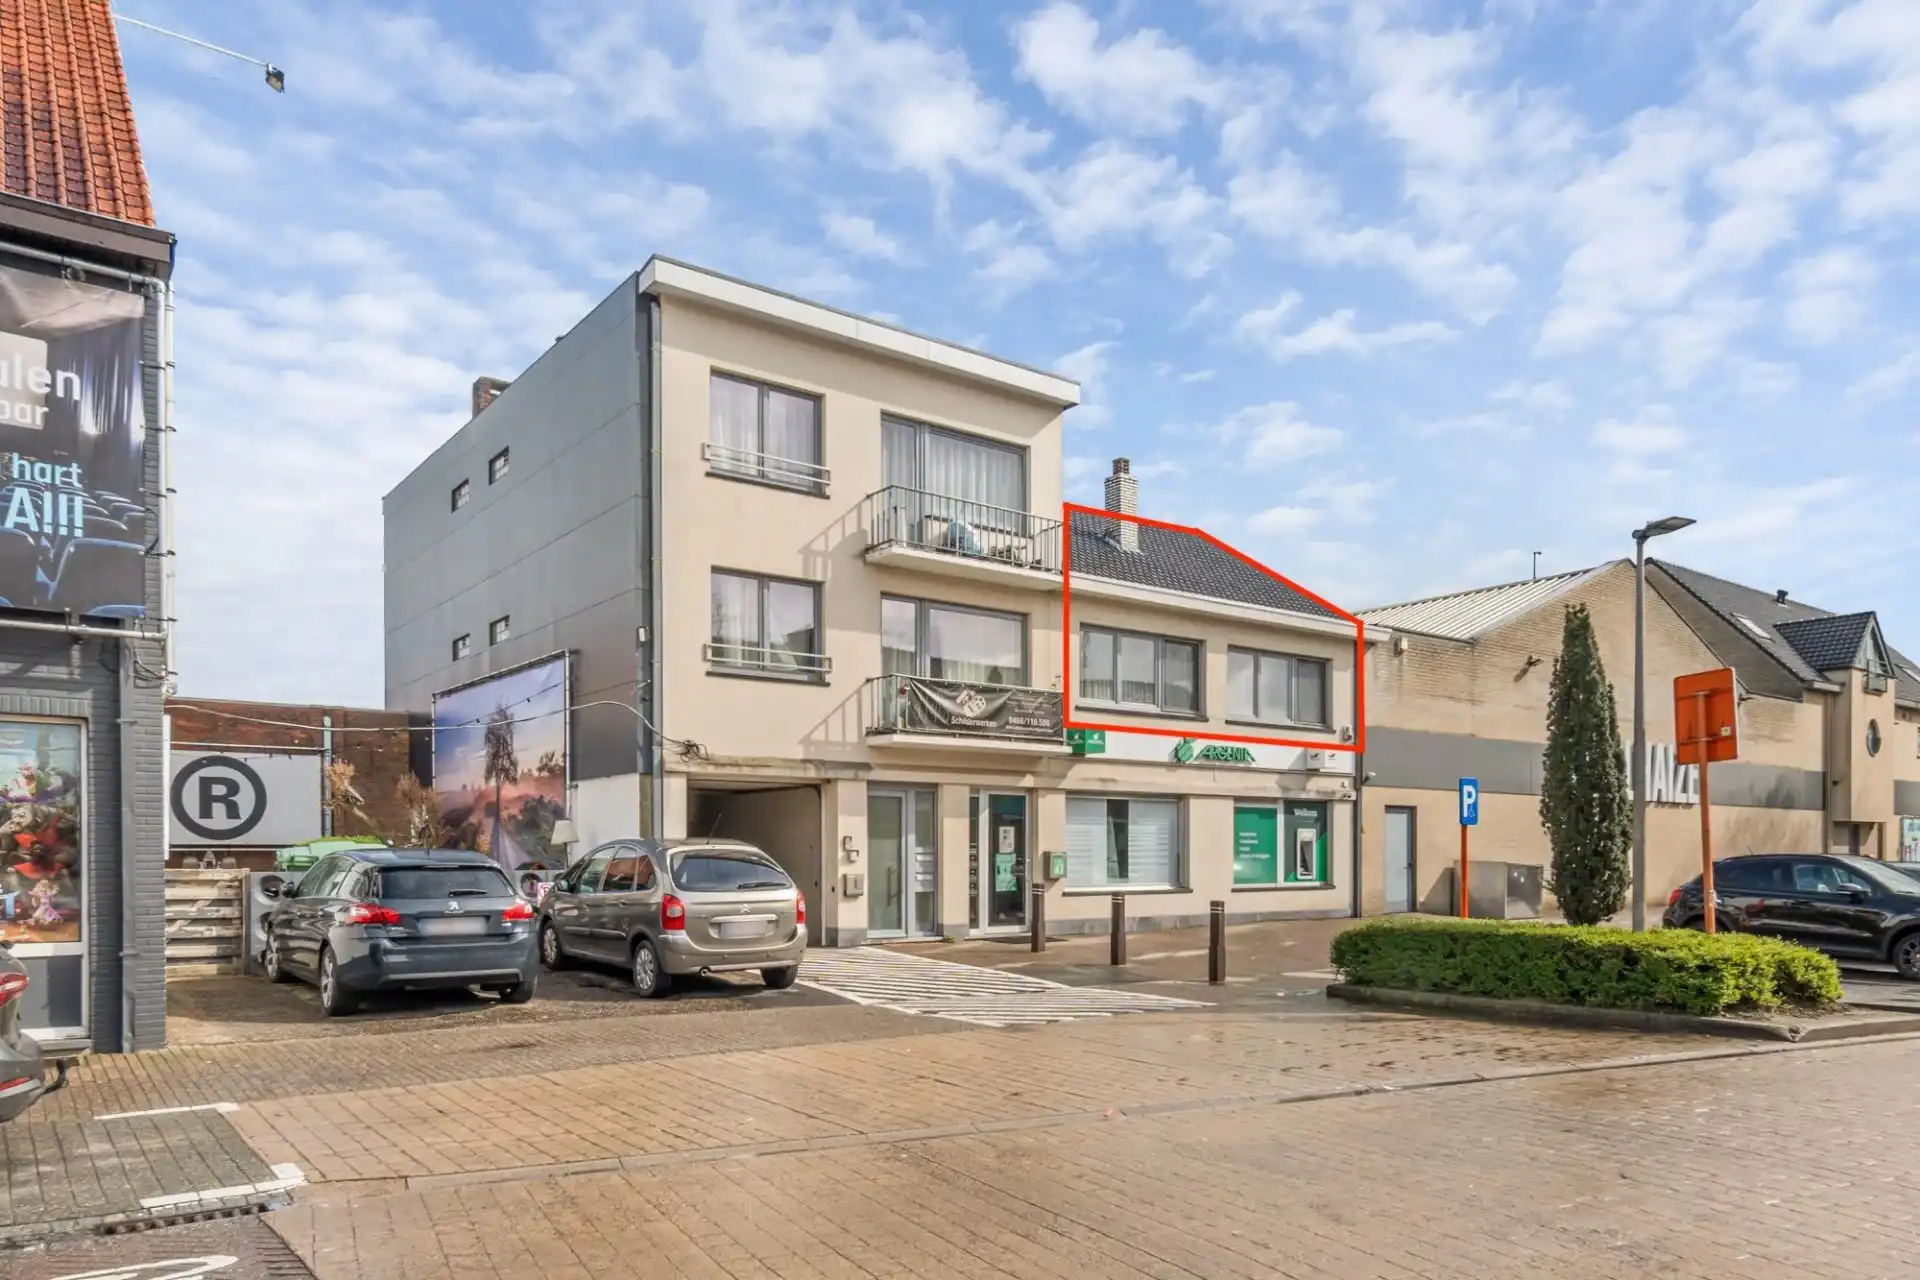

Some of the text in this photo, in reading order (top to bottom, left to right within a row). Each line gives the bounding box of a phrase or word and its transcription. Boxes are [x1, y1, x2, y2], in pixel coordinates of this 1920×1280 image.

[12, 452, 84, 489] hart
[4, 487, 83, 537] A!!!
[1463, 785, 1477, 818] P
